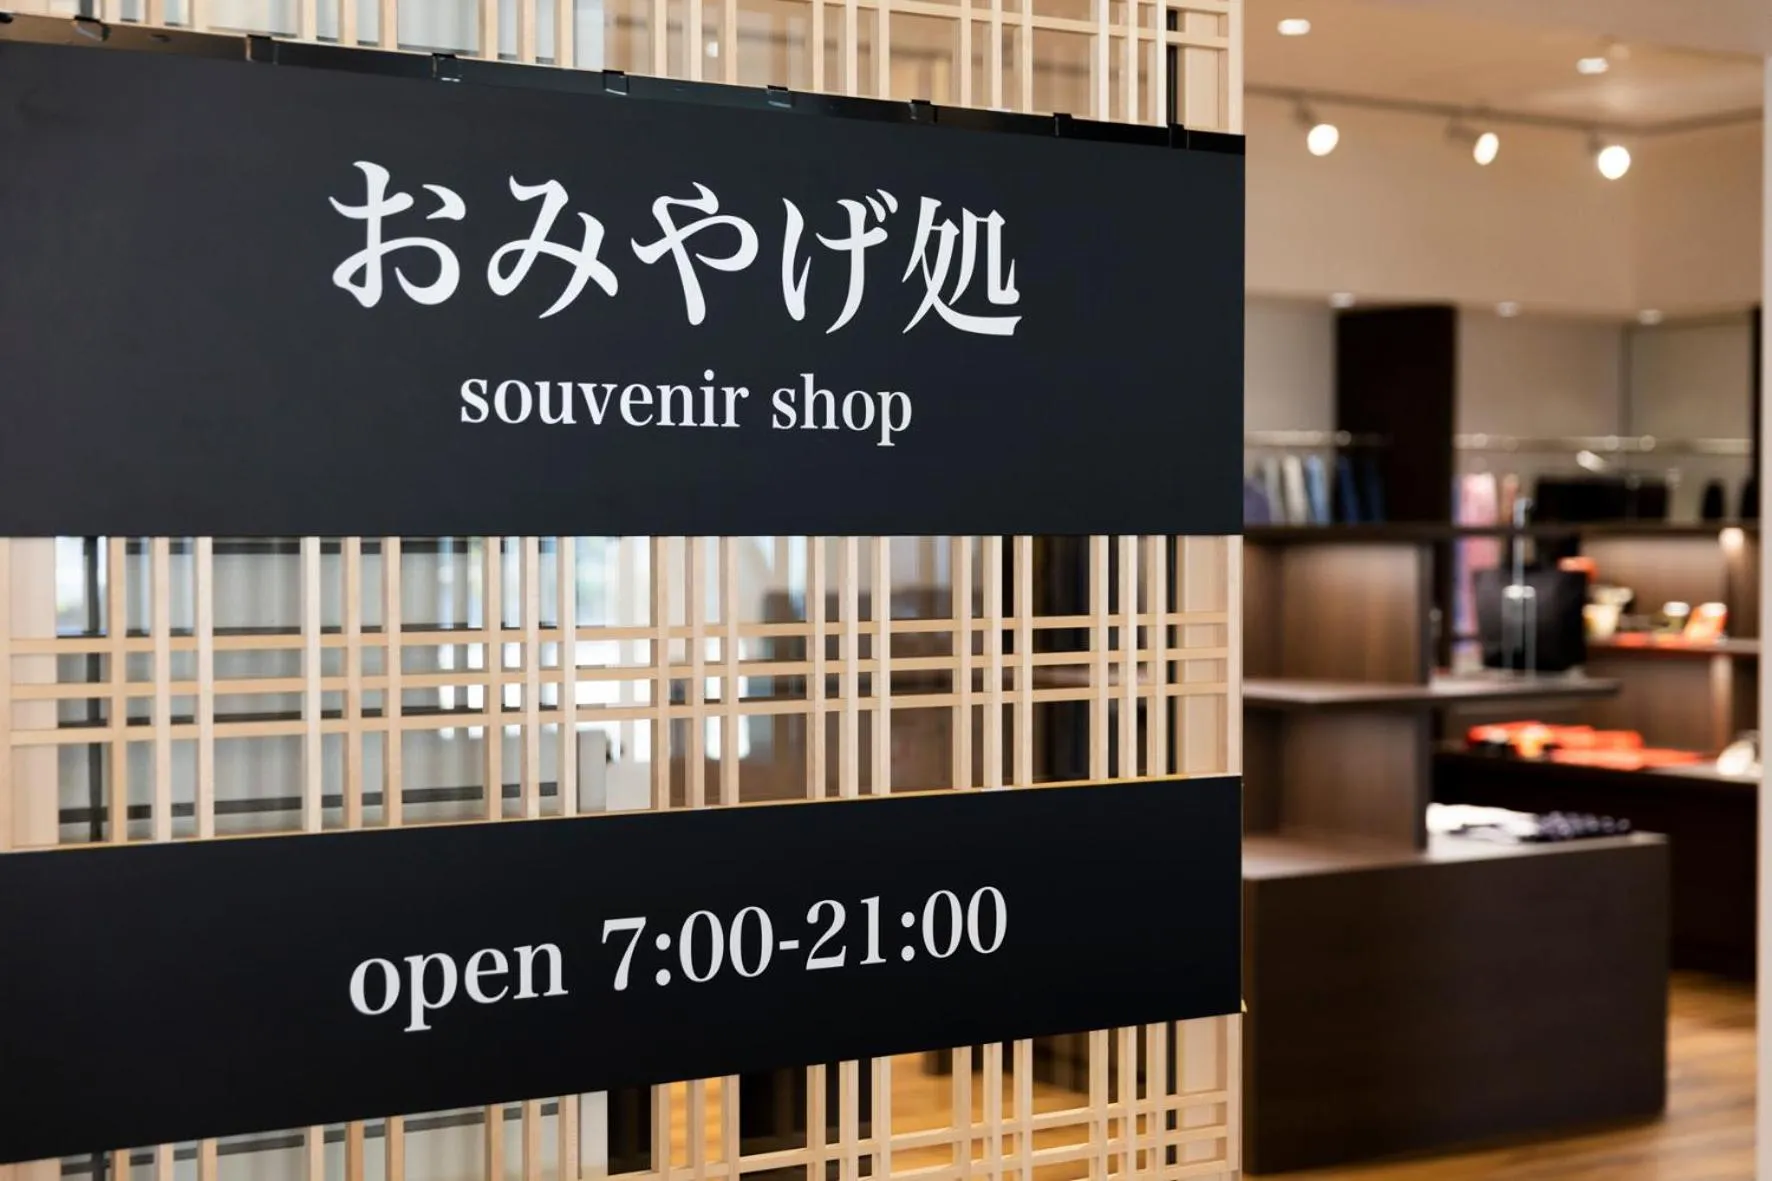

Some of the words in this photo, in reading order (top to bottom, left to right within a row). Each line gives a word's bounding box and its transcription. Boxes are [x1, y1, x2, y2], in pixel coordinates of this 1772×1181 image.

[328, 160, 1023, 336] おみやげ処
[460, 368, 750, 428] souvenir
[771, 372, 912, 447] shop
[349, 943, 569, 1033] open
[601, 886, 1007, 991] 7:00-21:00
